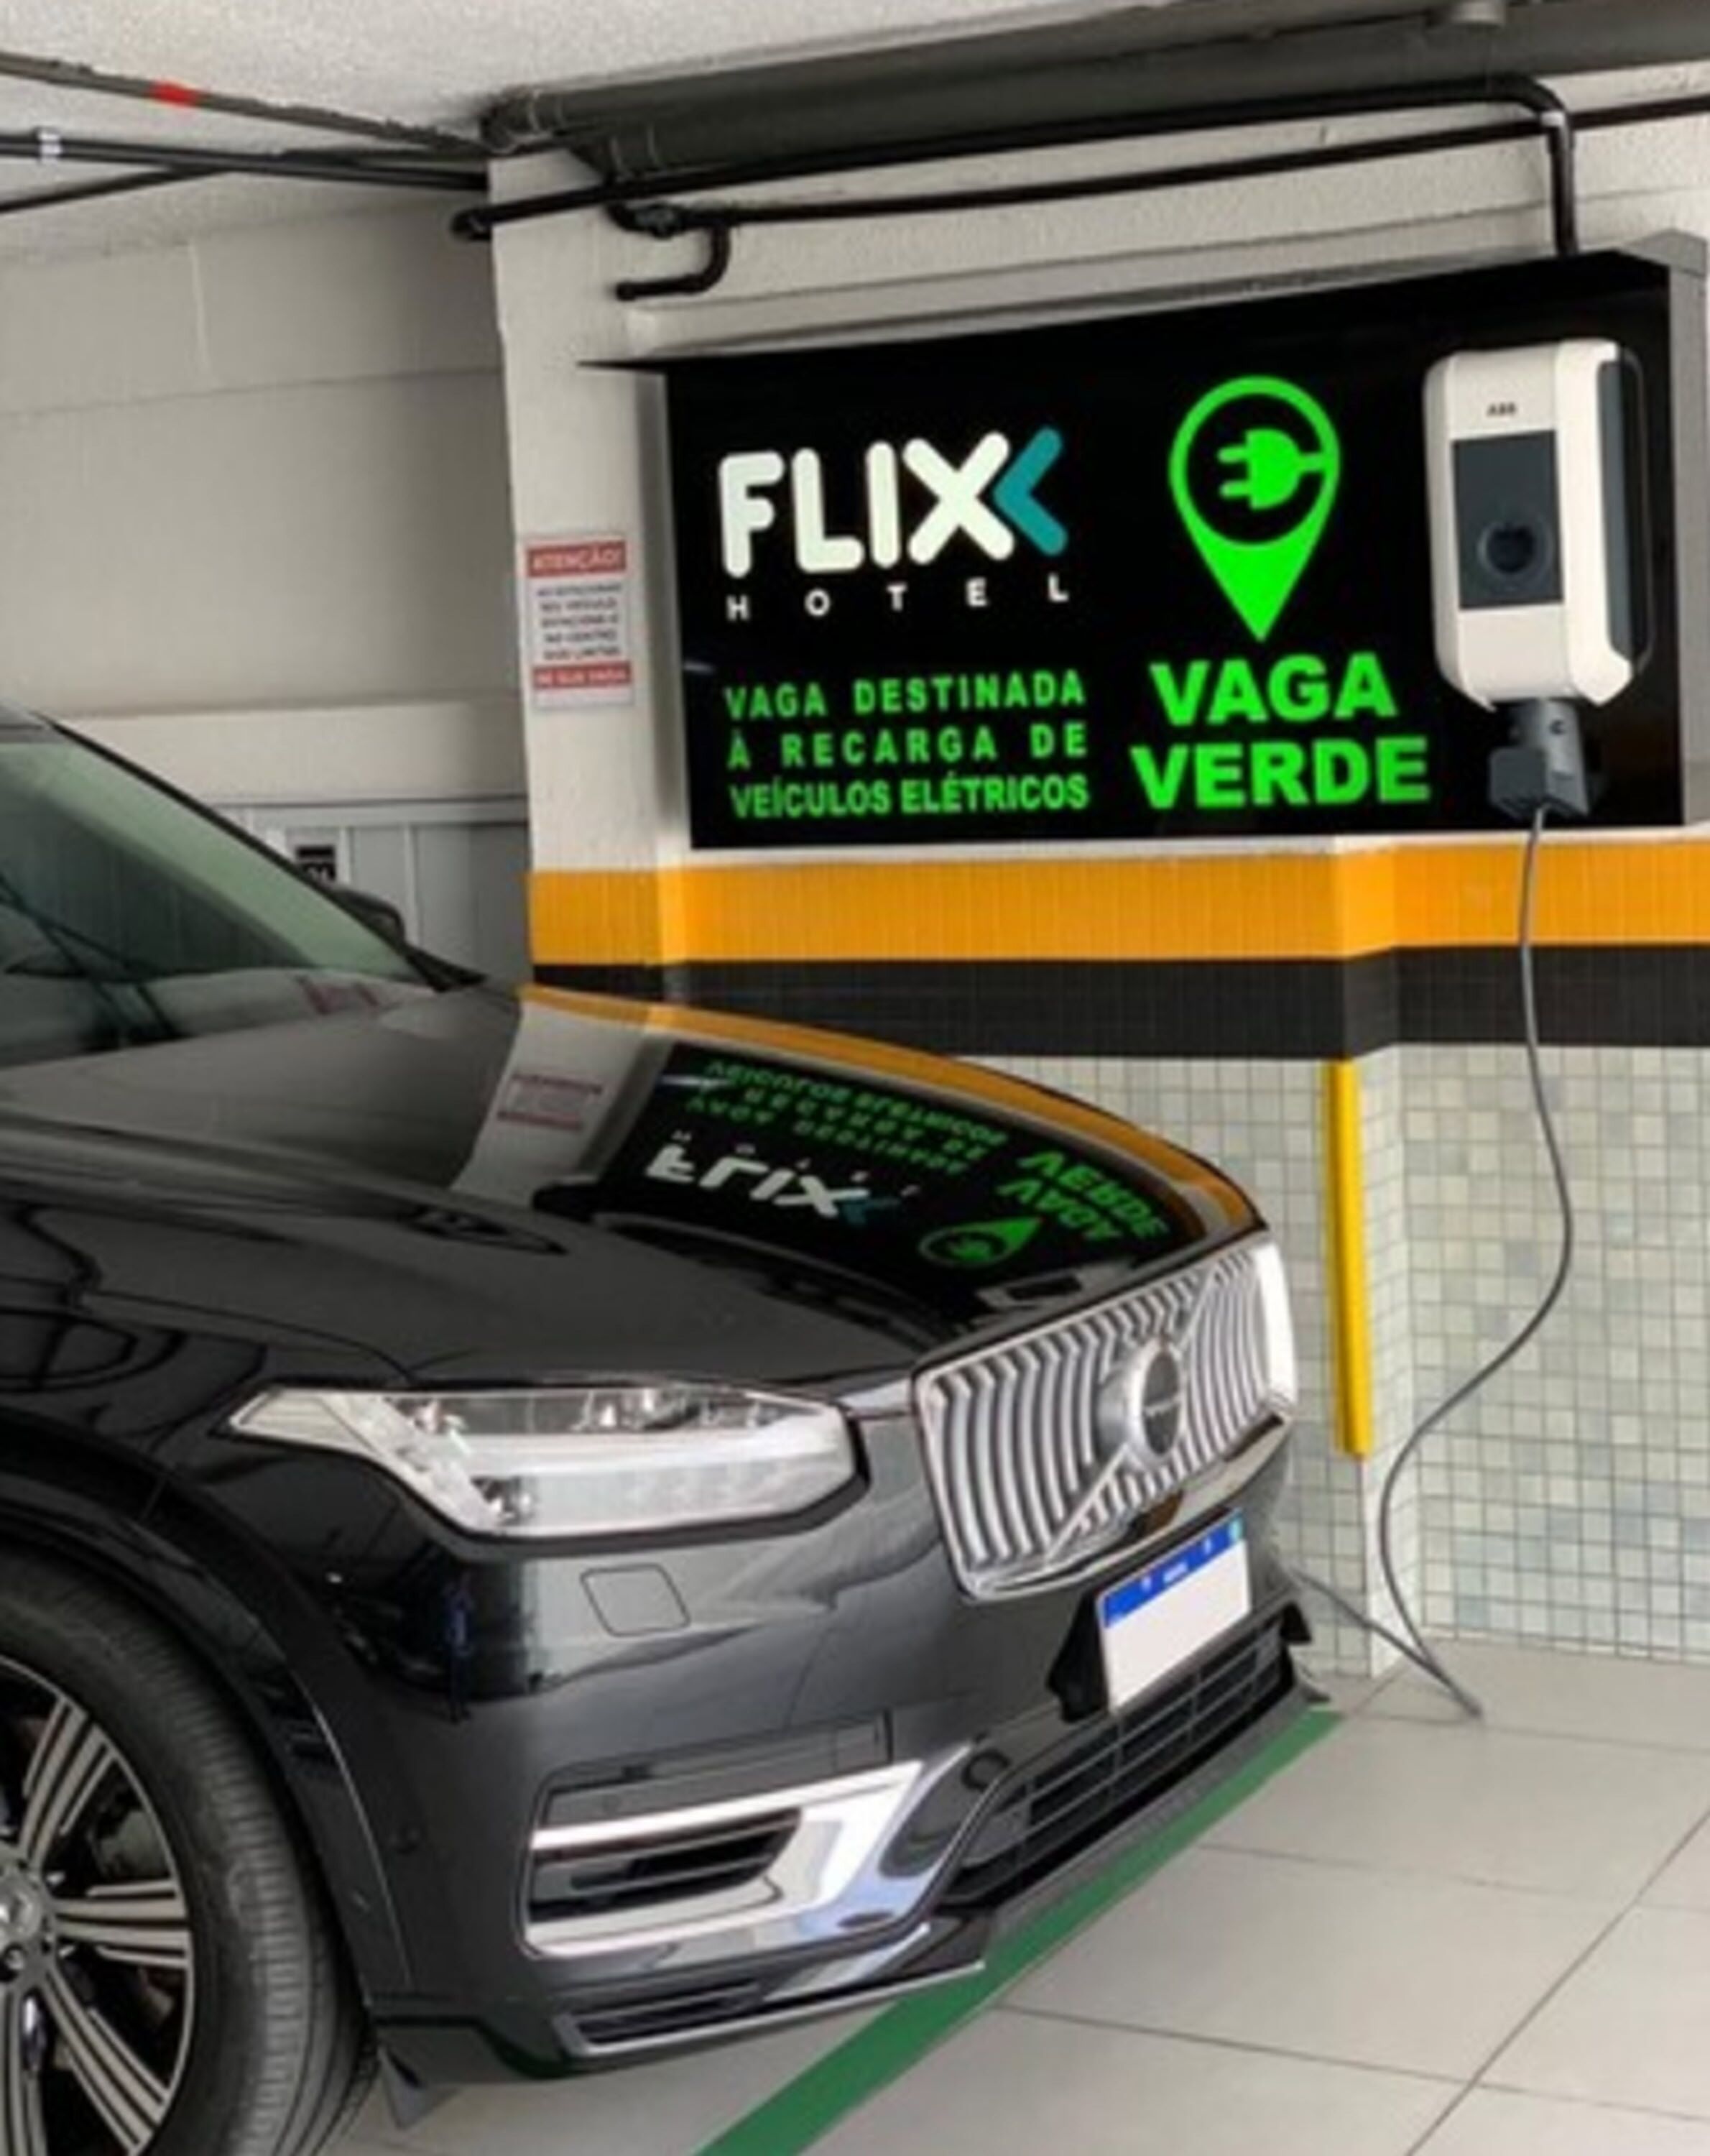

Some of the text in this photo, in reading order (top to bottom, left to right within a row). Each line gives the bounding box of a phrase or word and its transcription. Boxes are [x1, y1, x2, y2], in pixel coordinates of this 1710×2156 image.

[718, 432, 1015, 579] FLIX
[726, 572, 1070, 621] HOTEL
[725, 668, 1086, 720] VAGA DESTINADA
[1150, 652, 1397, 727] VAGA
[728, 721, 1088, 769] À RECARGA DE
[730, 770, 1091, 819] VEÍCULOS ELÉTRICOS
[1129, 735, 1431, 809] VERDE
